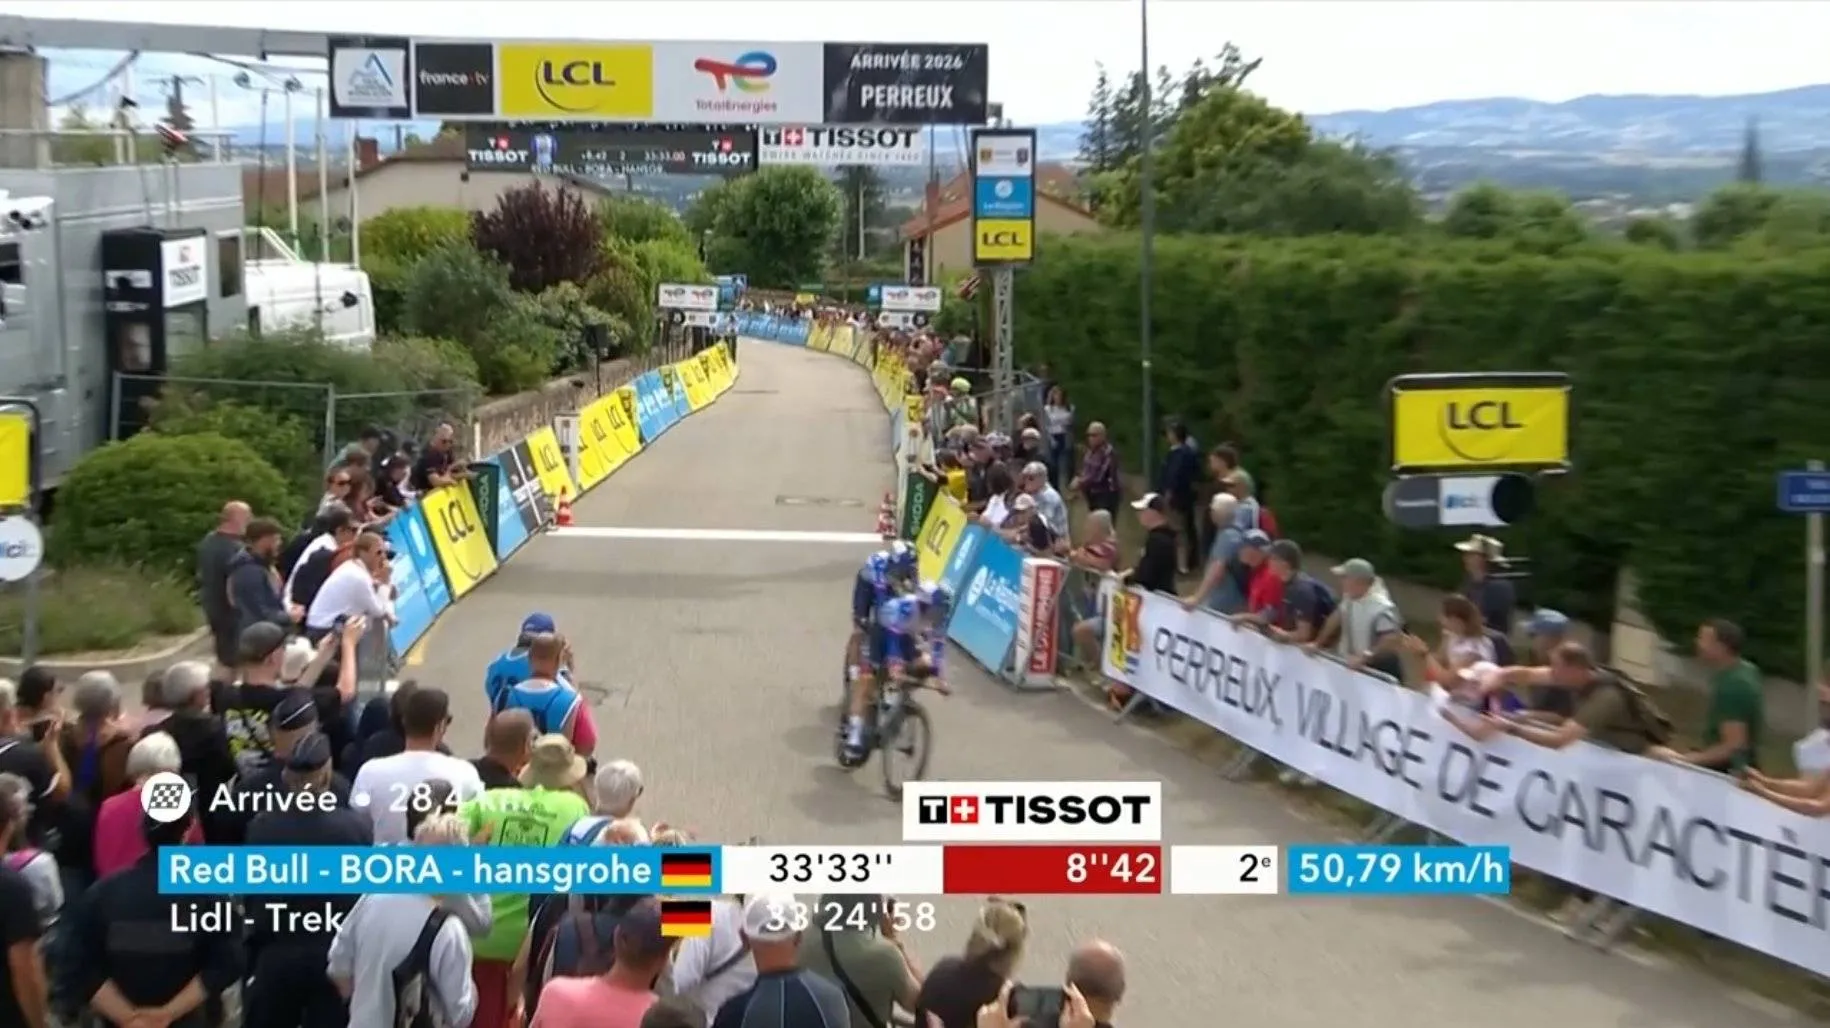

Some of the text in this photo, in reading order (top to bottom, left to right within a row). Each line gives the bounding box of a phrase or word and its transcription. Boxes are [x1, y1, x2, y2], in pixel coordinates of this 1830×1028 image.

[851, 49, 963, 69] ARRIVÉE 2026
[543, 60, 615, 86] LCL
[696, 99, 777, 114] TotalEnergies
[861, 84, 954, 108] PERREUX
[806, 127, 919, 149] TISSOT
[692, 151, 752, 165] TISSOT
[982, 231, 1025, 247] LCL
[1447, 400, 1524, 430] LCL
[438, 498, 475, 544] LCL
[1153, 626, 1284, 736] PERREUX,
[1296, 681, 1432, 790] VILLAGE
[1437, 741, 1511, 818] DE
